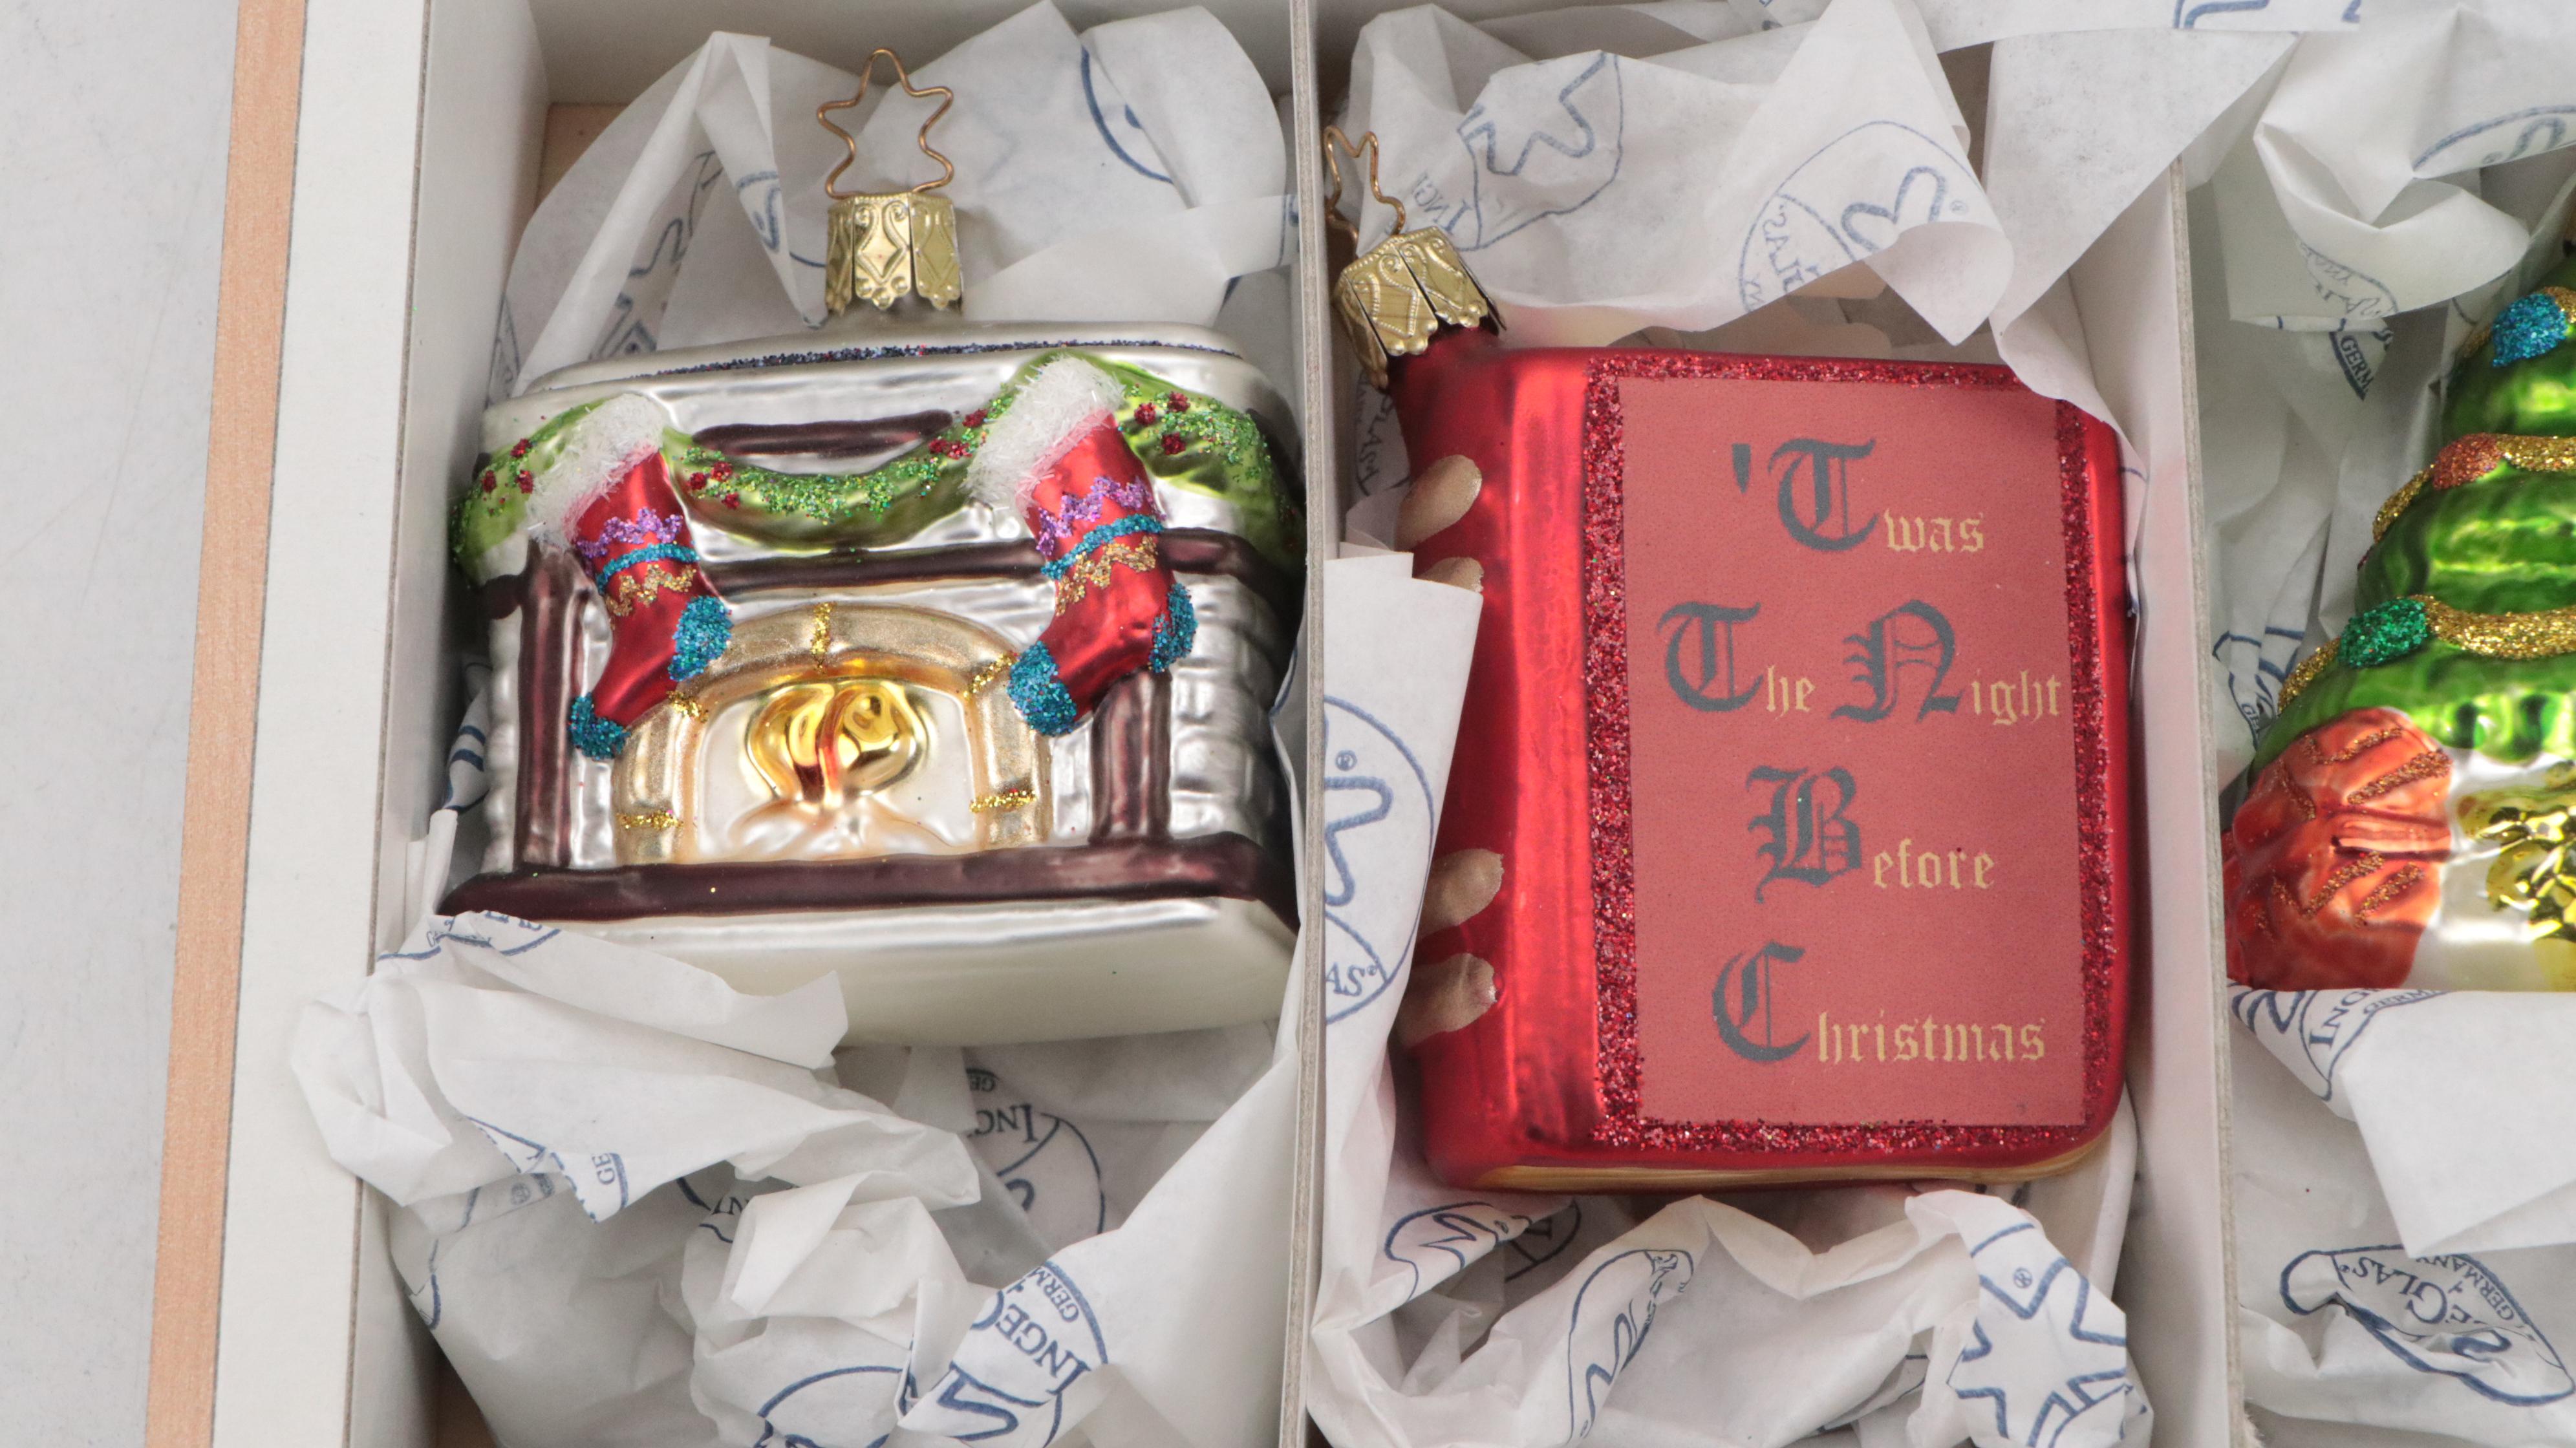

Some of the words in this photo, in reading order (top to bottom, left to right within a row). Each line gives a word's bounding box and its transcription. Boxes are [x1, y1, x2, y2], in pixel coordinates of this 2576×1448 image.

[2340, 335, 2374, 392] GERM
[1732, 438, 1984, 553] 'Twas
[1656, 601, 1816, 720] The
[1829, 599, 2062, 725] Night
[1746, 766, 1995, 904] Before
[1712, 940, 2045, 1065] Christmas
[1027, 1266, 1079, 1323] GERM
